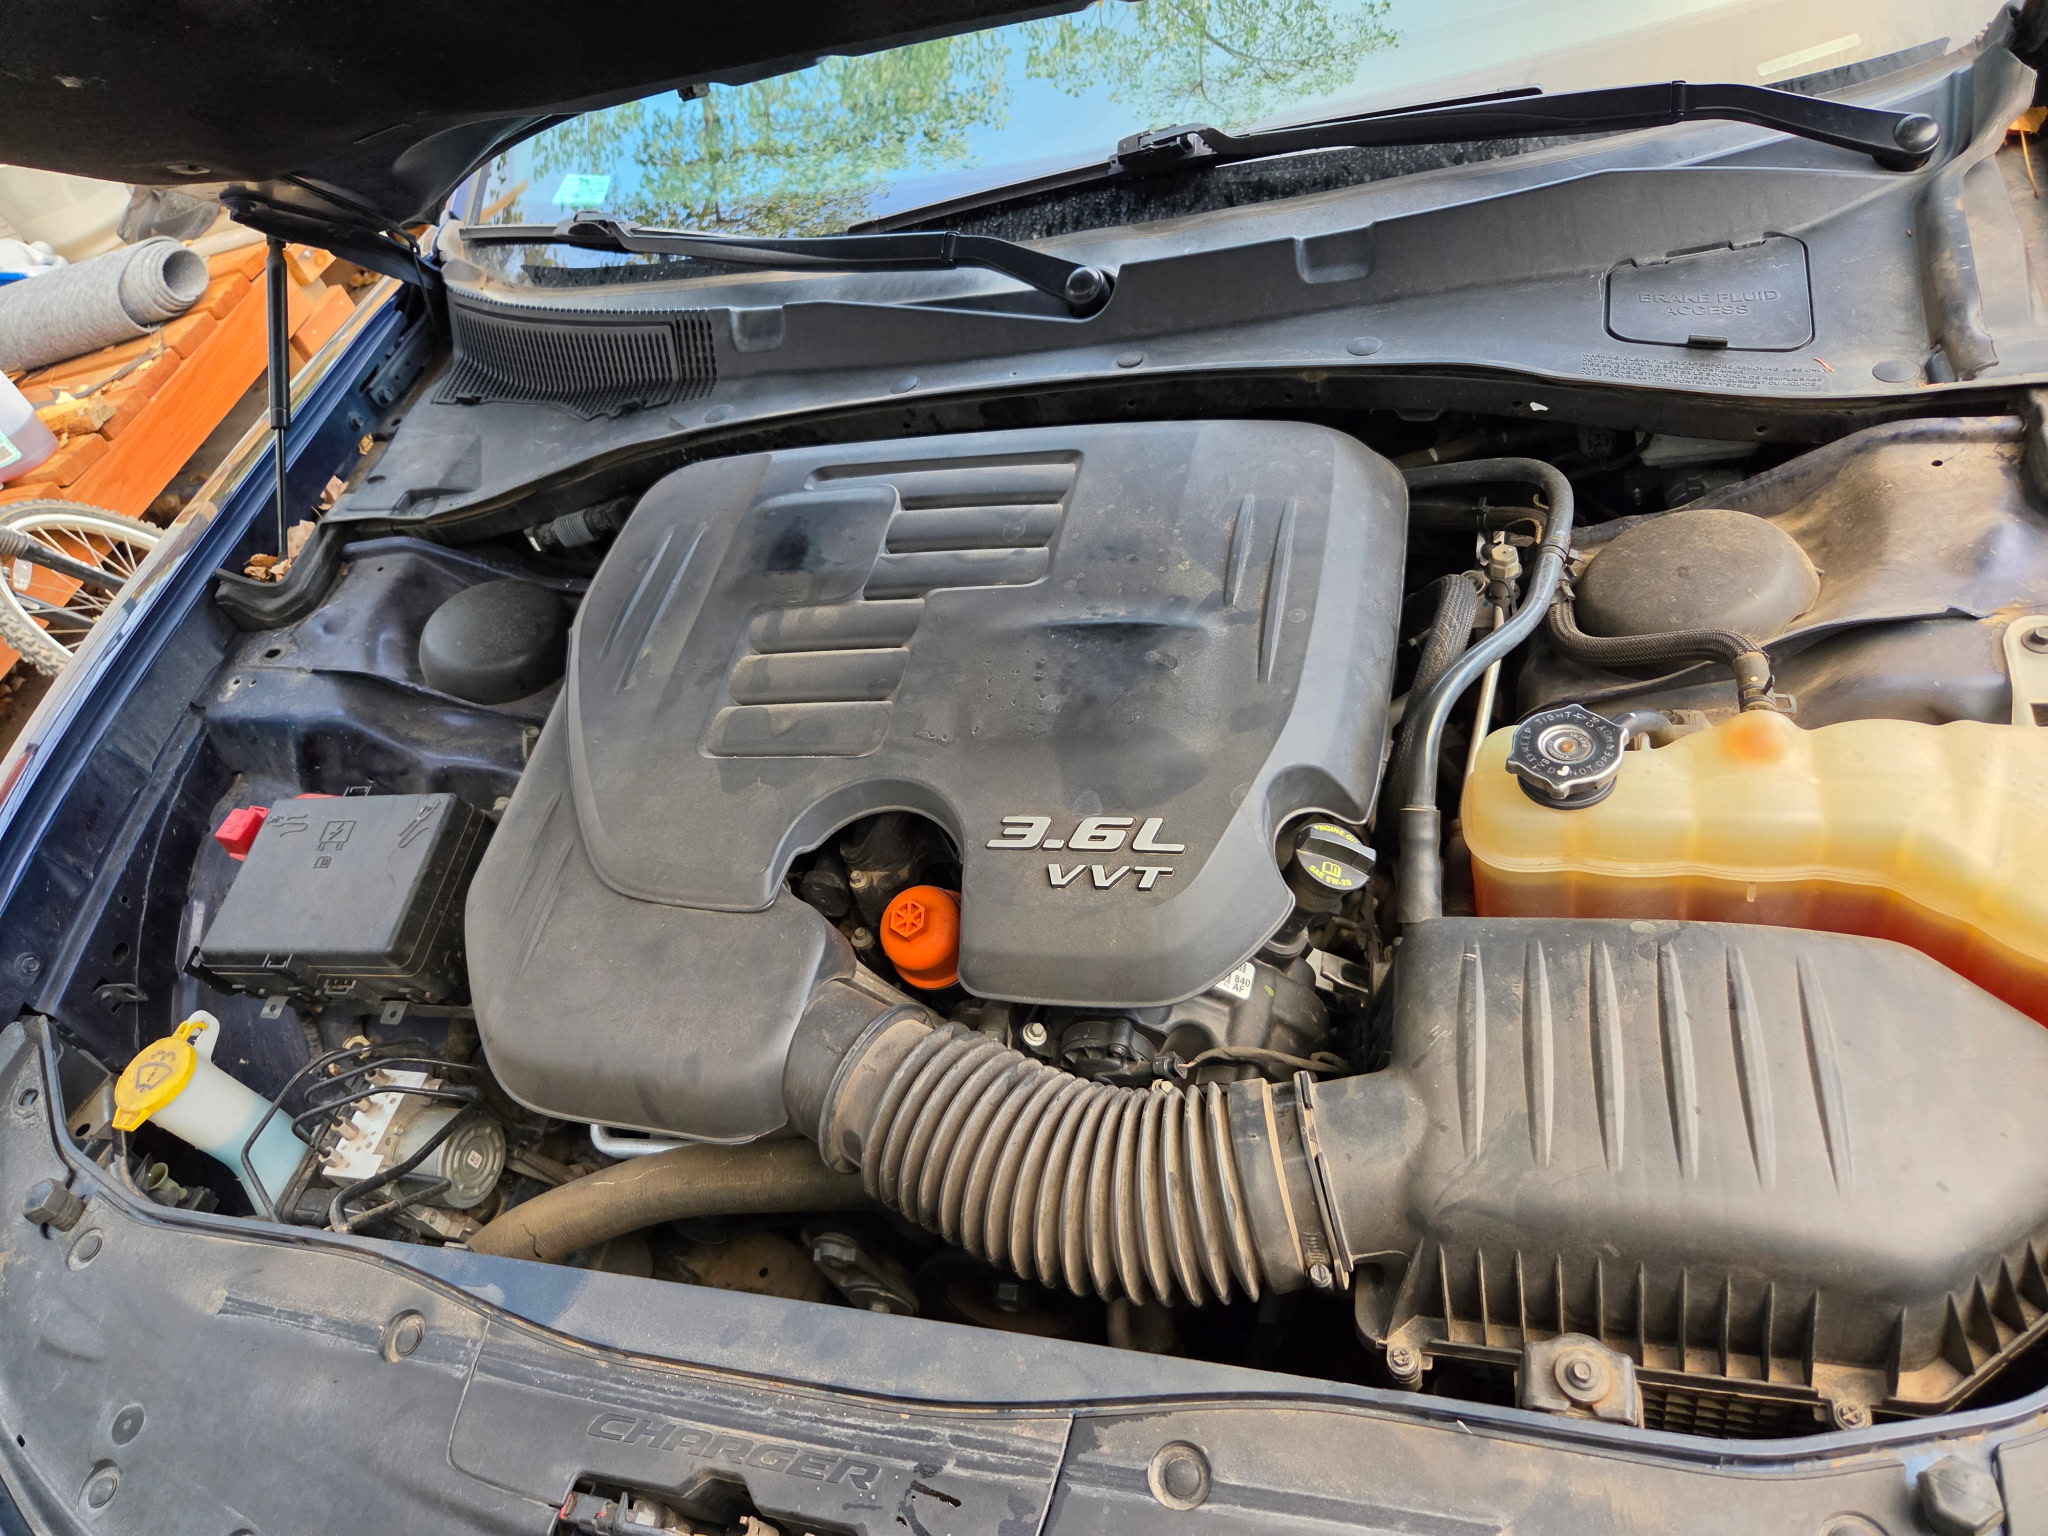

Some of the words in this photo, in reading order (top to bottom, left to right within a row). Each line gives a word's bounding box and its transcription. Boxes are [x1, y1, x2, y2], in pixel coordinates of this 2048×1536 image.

[1638, 291, 1710, 304] BRAKE
[1717, 290, 1778, 303] FLUID
[1663, 304, 1750, 316] ACCESS
[1534, 711, 1572, 725] TIGHT
[986, 816, 1186, 854] 3.6L
[1047, 863, 1174, 891] VVT
[1308, 864, 1325, 879] SAE
[1232, 983, 1245, 992] AF
[586, 1412, 882, 1490] CHARGER
